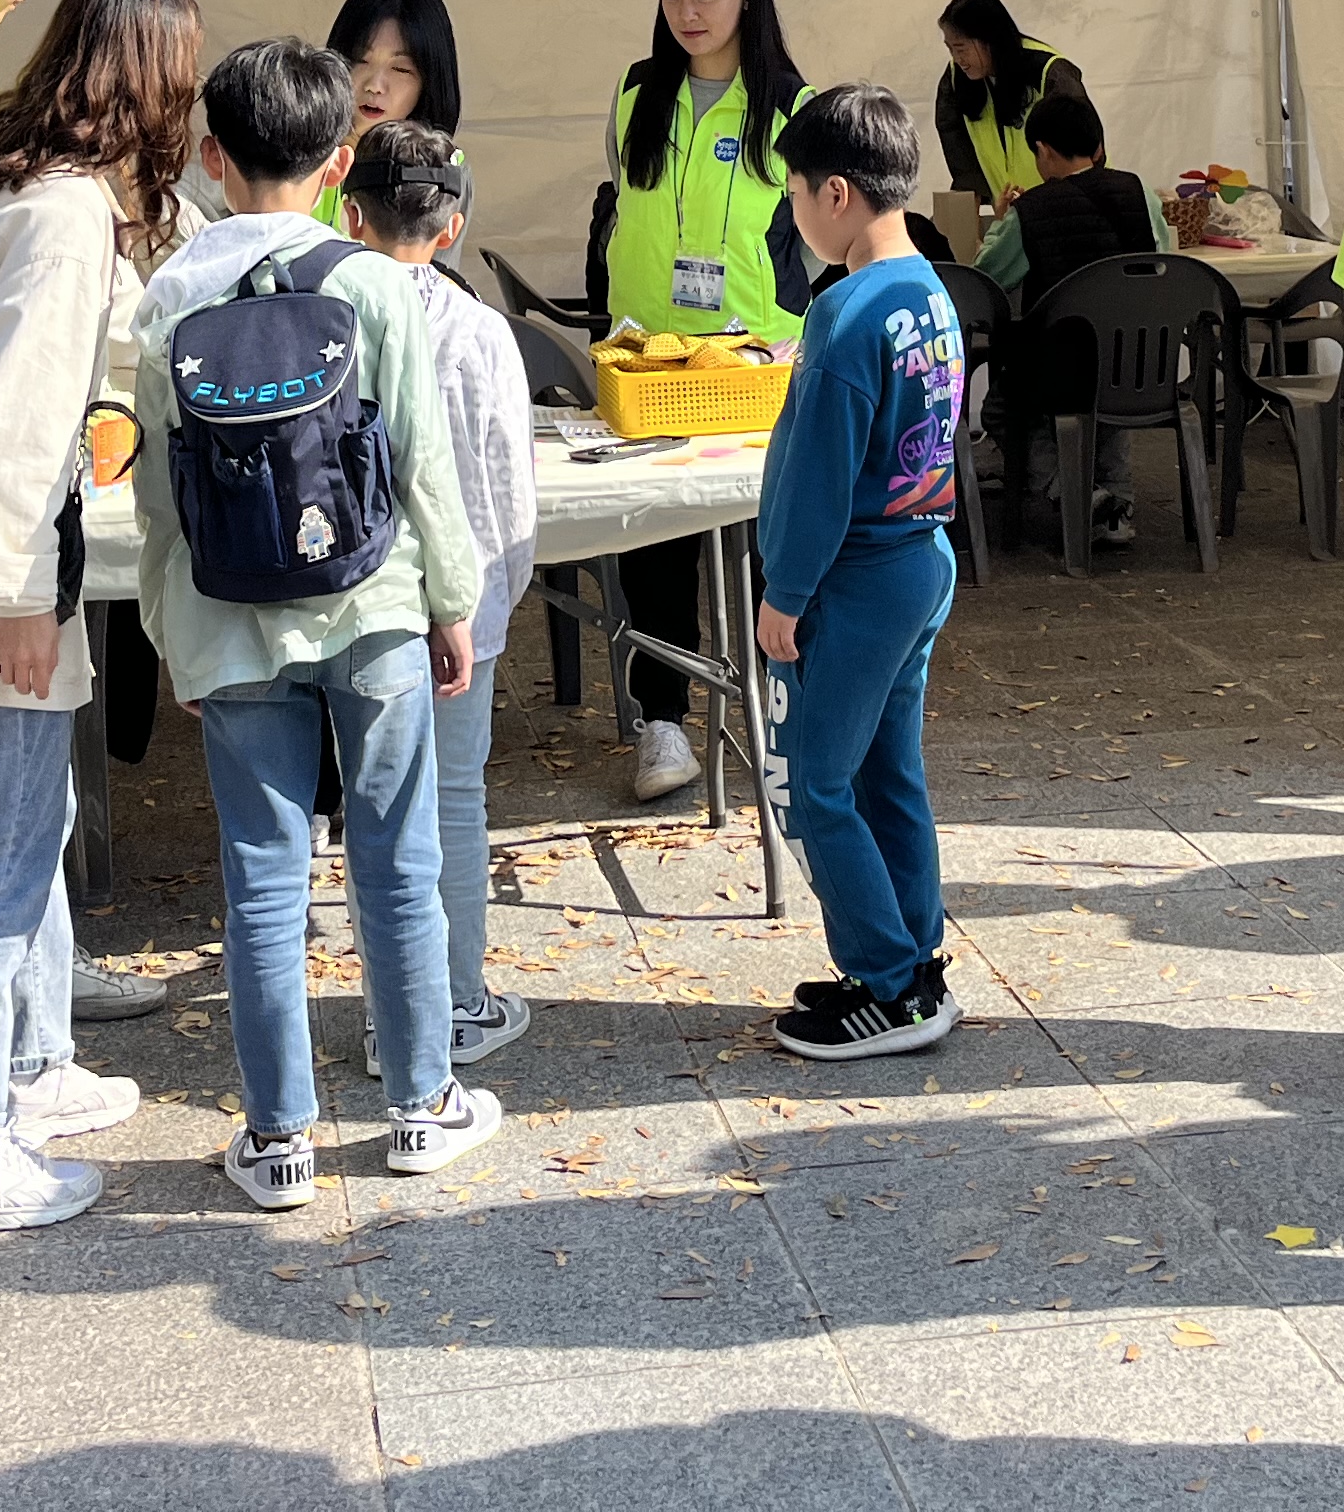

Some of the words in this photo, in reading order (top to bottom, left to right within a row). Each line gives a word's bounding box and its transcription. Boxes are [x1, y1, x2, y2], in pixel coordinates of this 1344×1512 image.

[190, 368, 326, 405] FLYBOT
[390, 1129, 426, 1152] IKE
[270, 1158, 312, 1186] NIKE
